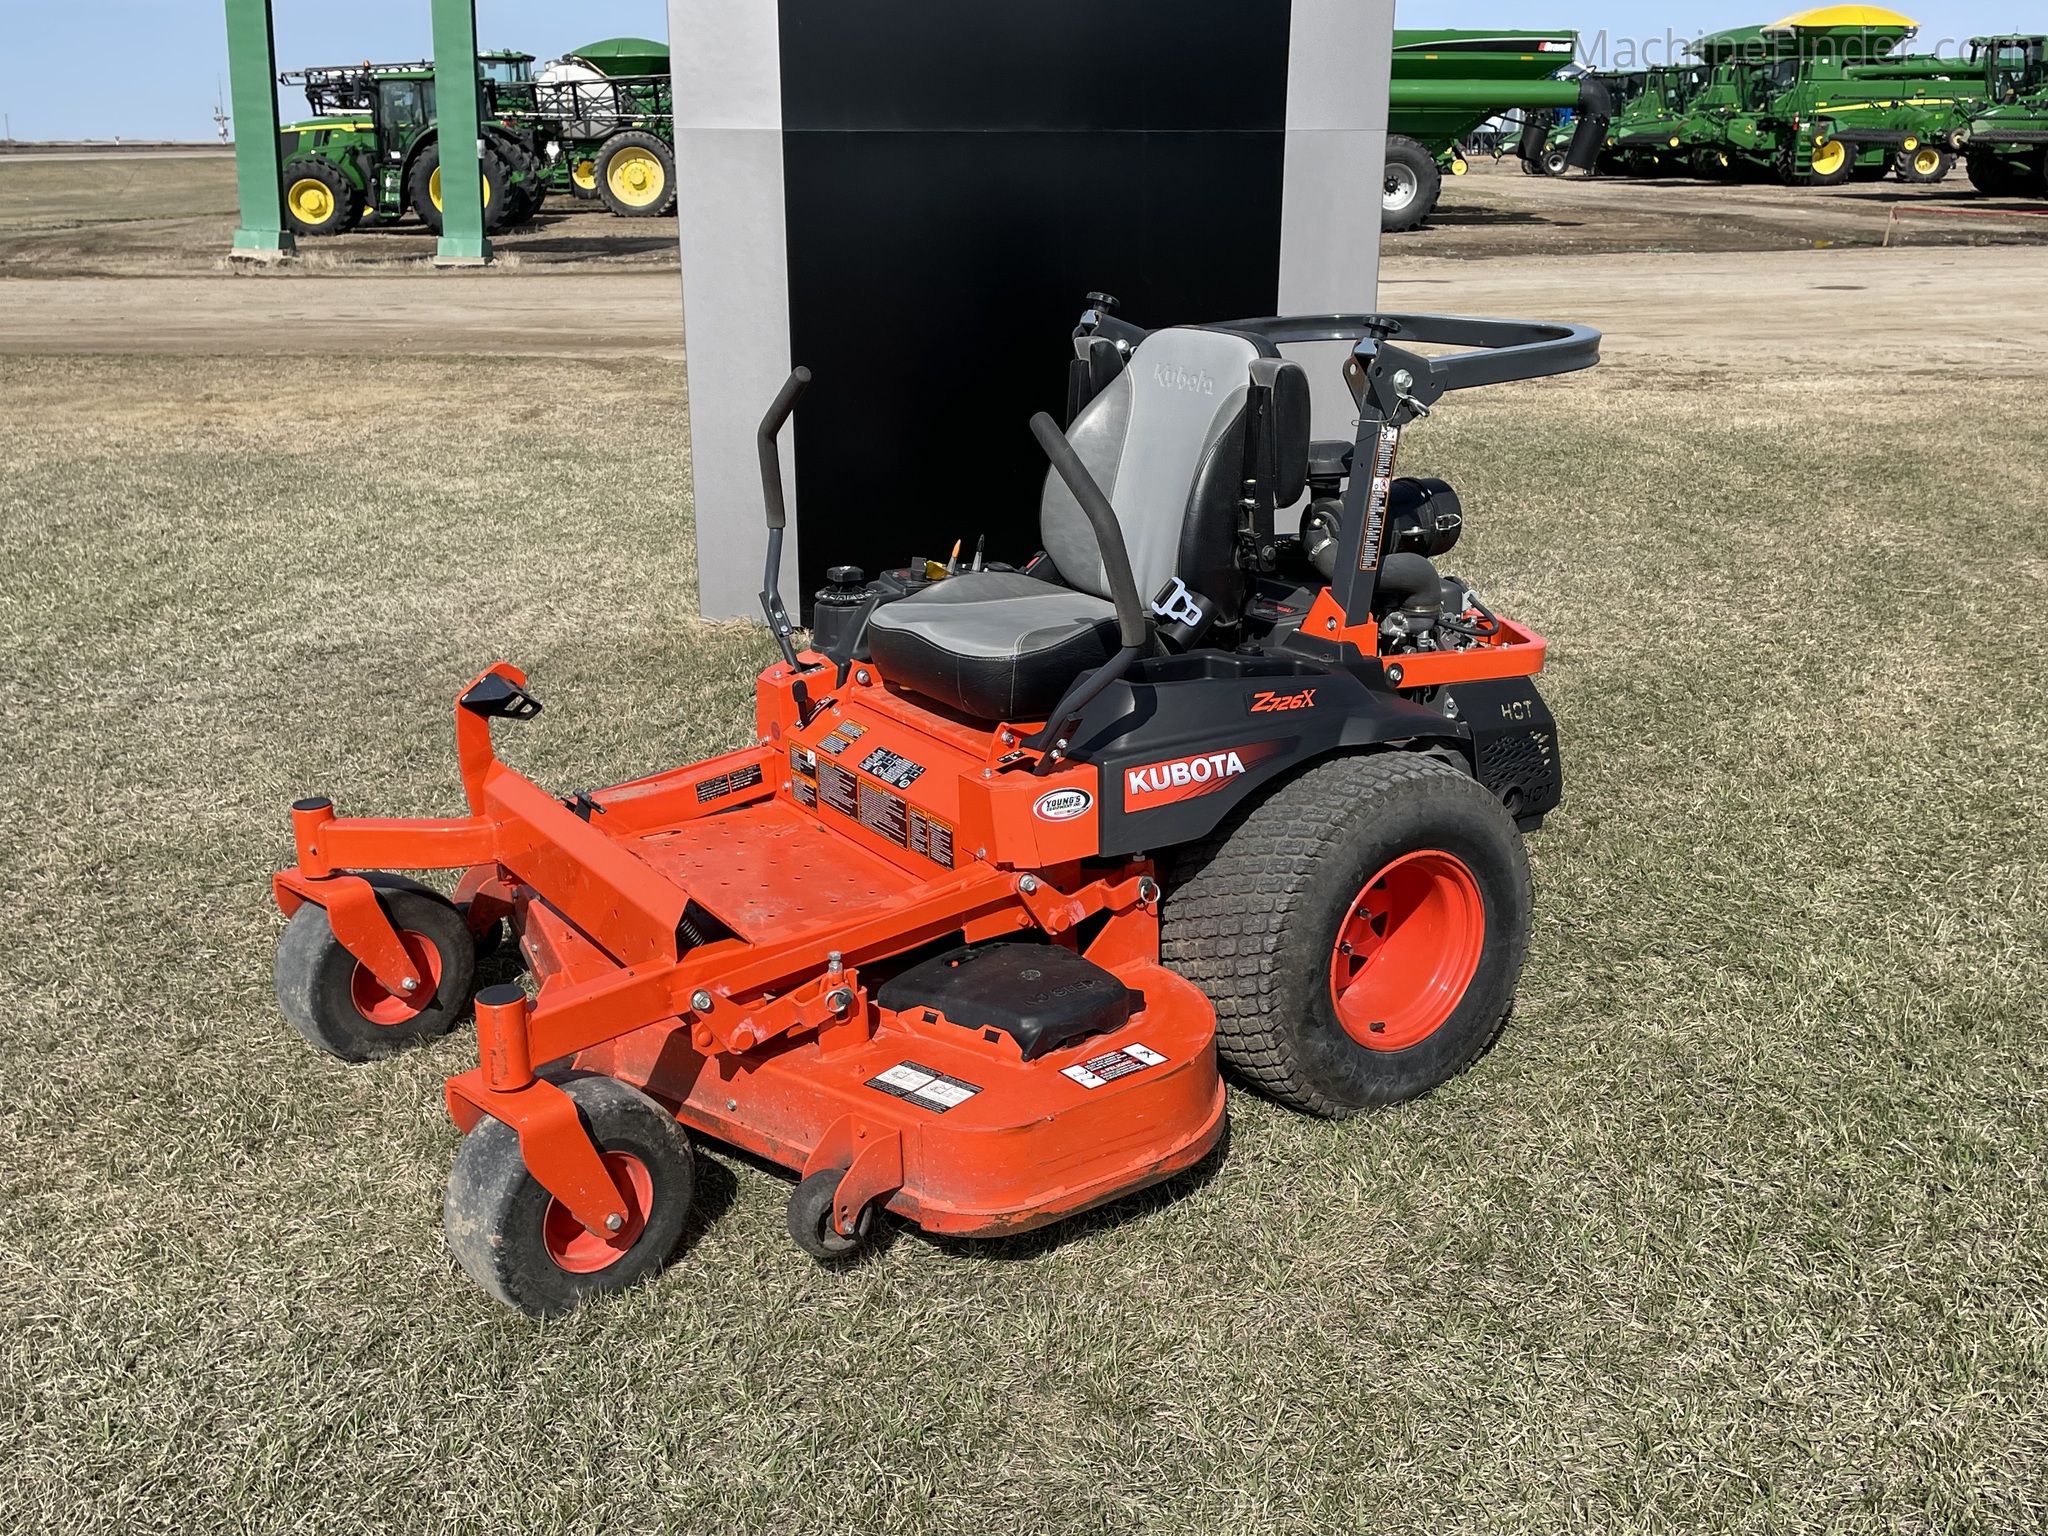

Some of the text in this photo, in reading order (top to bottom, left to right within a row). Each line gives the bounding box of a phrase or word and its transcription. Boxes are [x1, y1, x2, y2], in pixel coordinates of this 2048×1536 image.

[1153, 363, 1215, 395] Kubota
[1250, 688, 1317, 713] Z726X
[1500, 700, 1532, 720] HOT
[1128, 751, 1246, 795] KUBOTA
[1046, 795, 1081, 808] YOUNG'S
[1524, 782, 1555, 803] HOT
